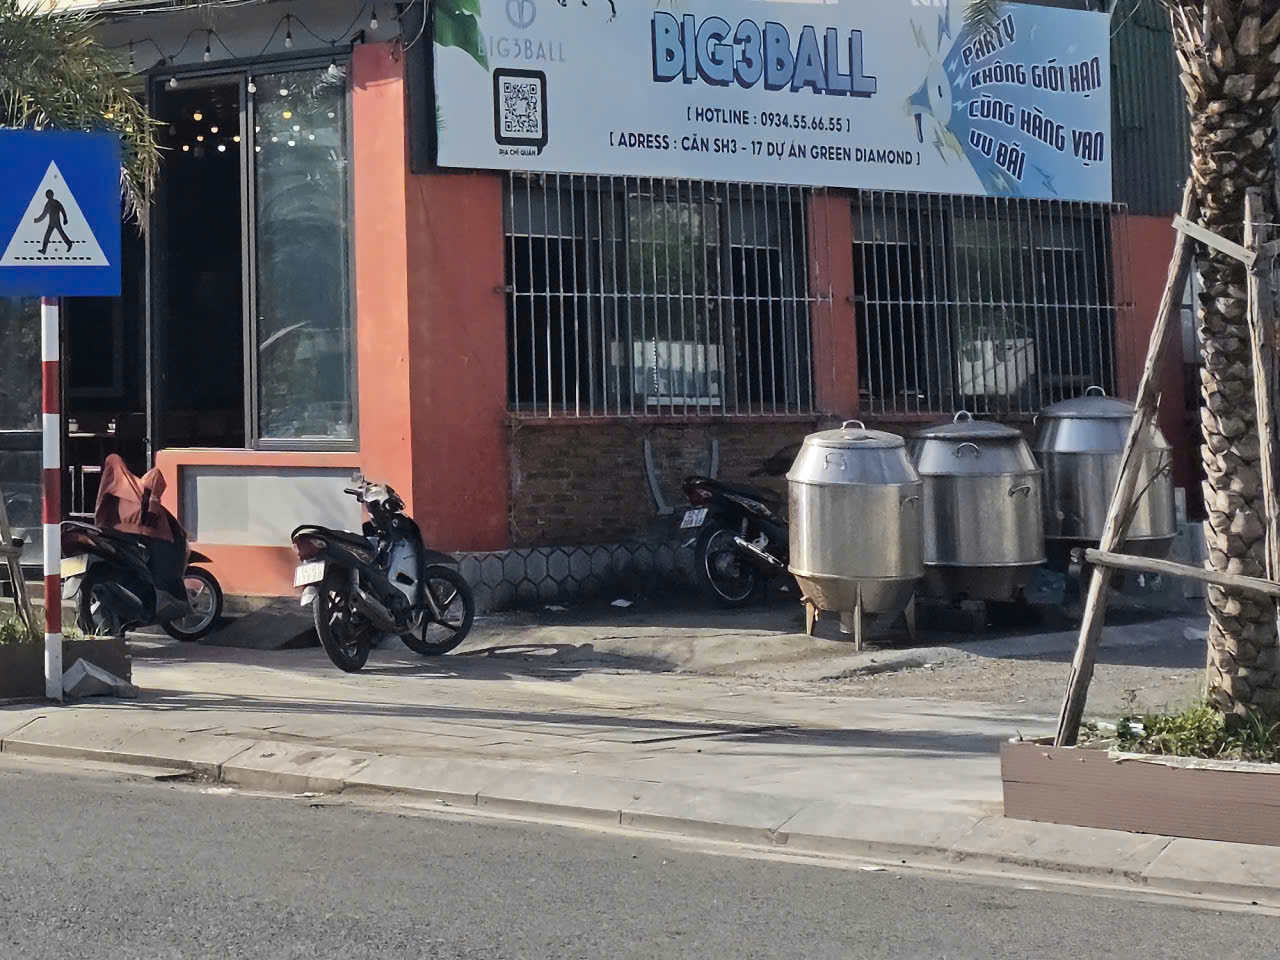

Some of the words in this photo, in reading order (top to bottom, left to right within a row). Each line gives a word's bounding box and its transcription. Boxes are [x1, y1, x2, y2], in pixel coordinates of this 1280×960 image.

[650, 10, 878, 98] BIG3BALL
[962, 14, 1016, 66] PARTY
[971, 60, 1027, 88] KHÔNG
[1069, 56, 1102, 98] HẠN
[695, 107, 749, 125] HOTLINE
[760, 111, 842, 132] 0934.55.66.55
[1020, 106, 1066, 152] HÀNG
[1072, 129, 1105, 167] VẠN
[617, 132, 670, 151] ADRESS
[713, 138, 737, 155] SH3
[751, 140, 762, 156] 17
[810, 144, 851, 162] GREEN
[855, 147, 913, 166] DIAMOND
[995, 142, 1026, 180] ĐÃI
